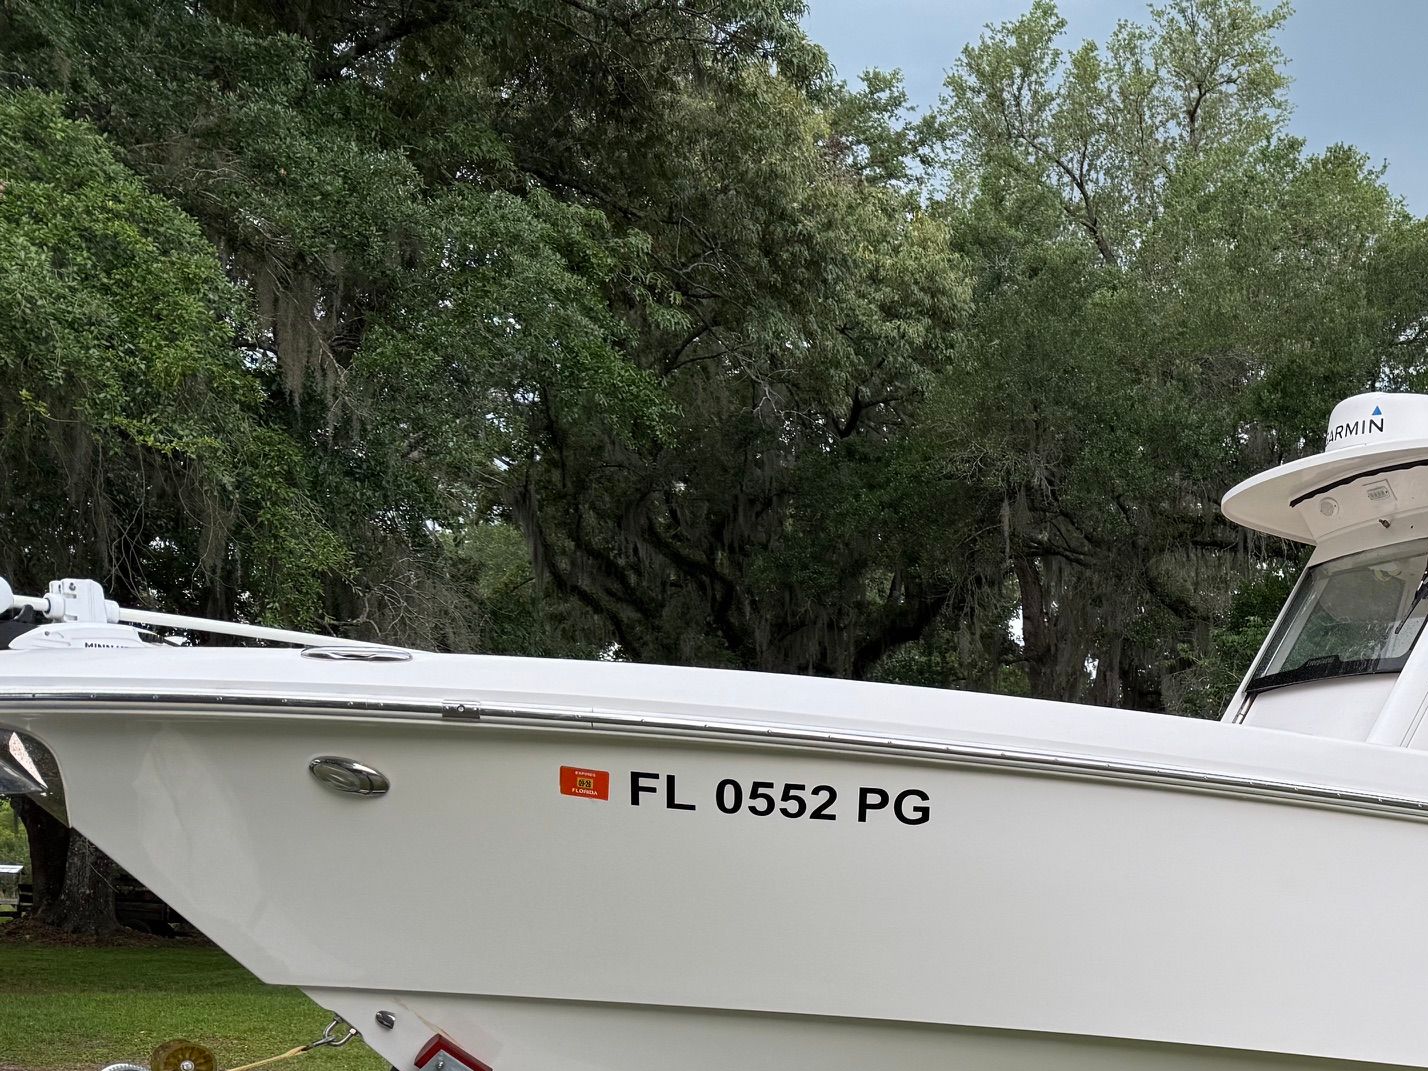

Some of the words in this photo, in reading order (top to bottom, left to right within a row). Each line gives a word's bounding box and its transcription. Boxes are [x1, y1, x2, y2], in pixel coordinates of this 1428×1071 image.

[572, 788, 598, 796] FLORIDA
[630, 771, 696, 811] FL
[715, 779, 838, 821] 0552
[857, 787, 931, 825] PG
